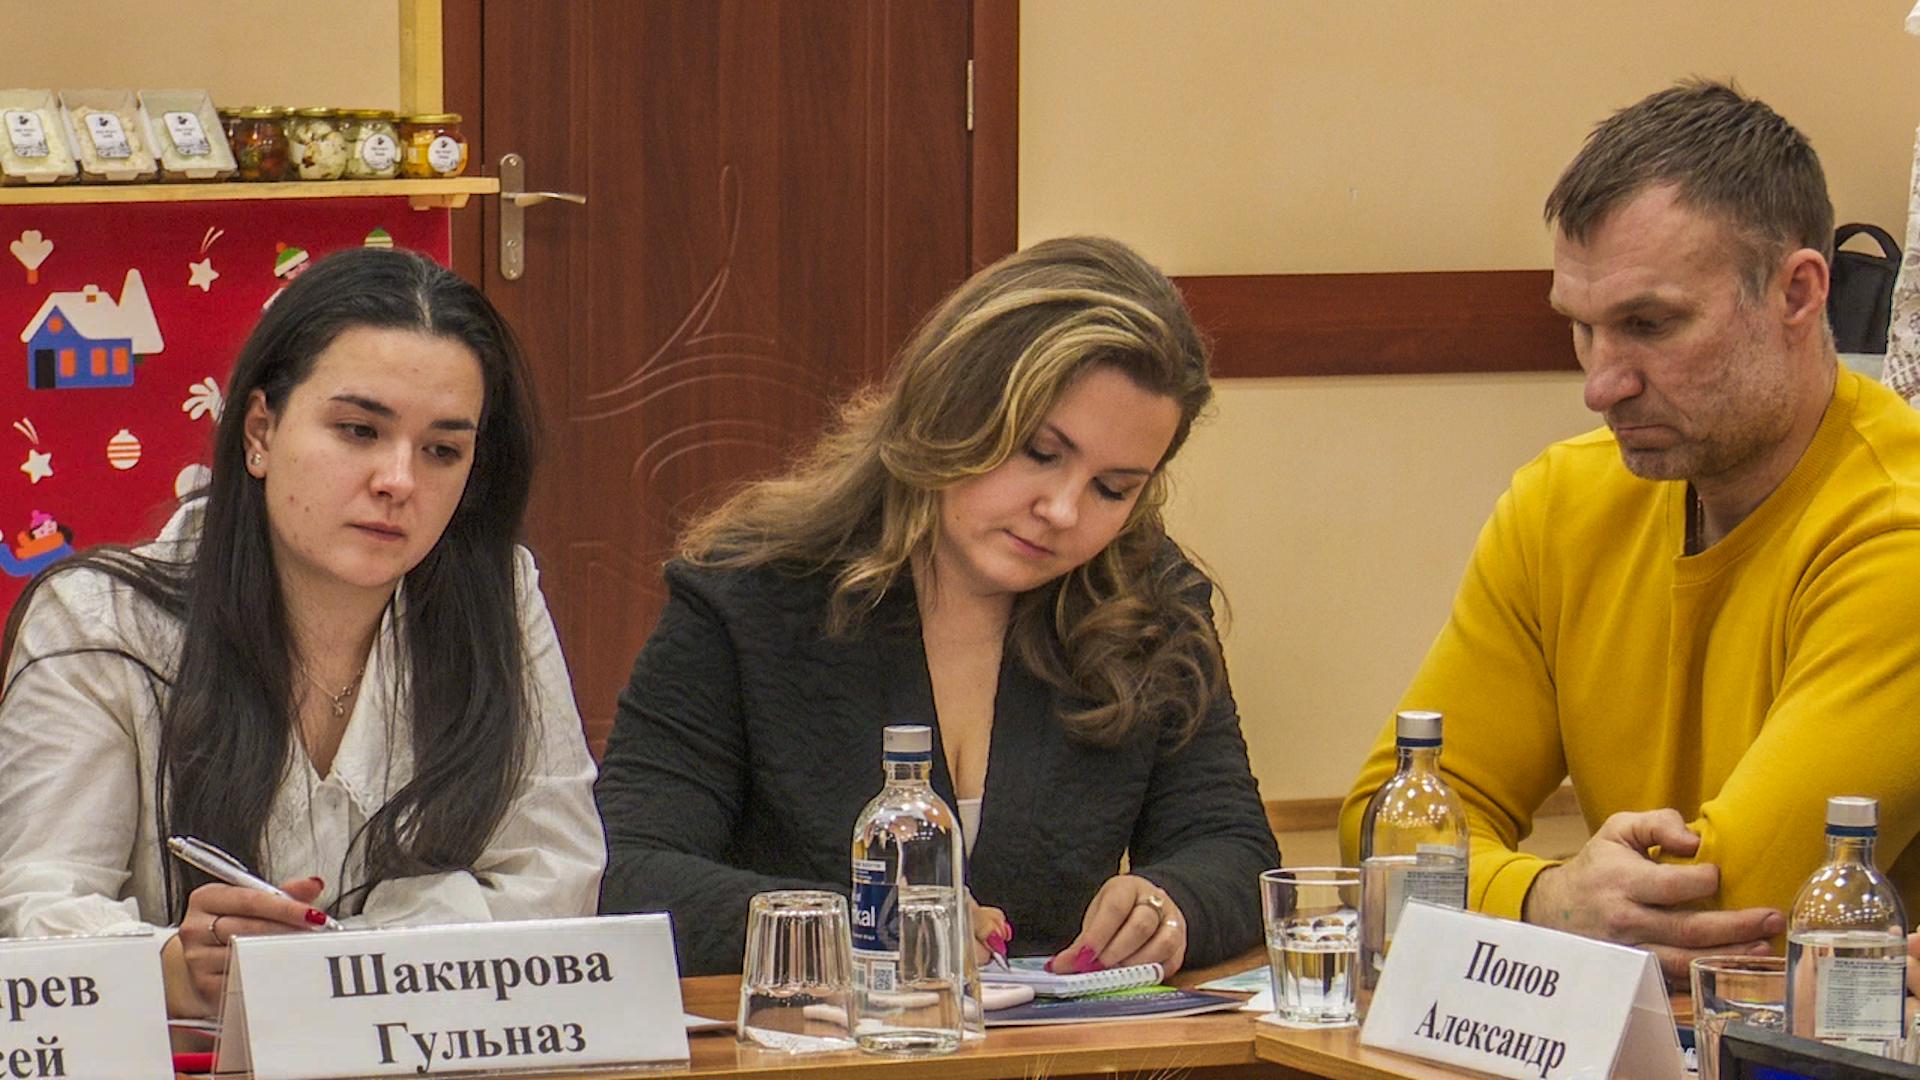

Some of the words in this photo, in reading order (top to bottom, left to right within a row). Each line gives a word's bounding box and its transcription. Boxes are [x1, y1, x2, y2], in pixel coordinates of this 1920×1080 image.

[324, 951, 614, 1001] Шакирова
[1464, 940, 1560, 998] Попов
[0, 975, 100, 1022] рев
[372, 1021, 587, 1074] Гульназ
[1414, 999, 1567, 1079] Александр
